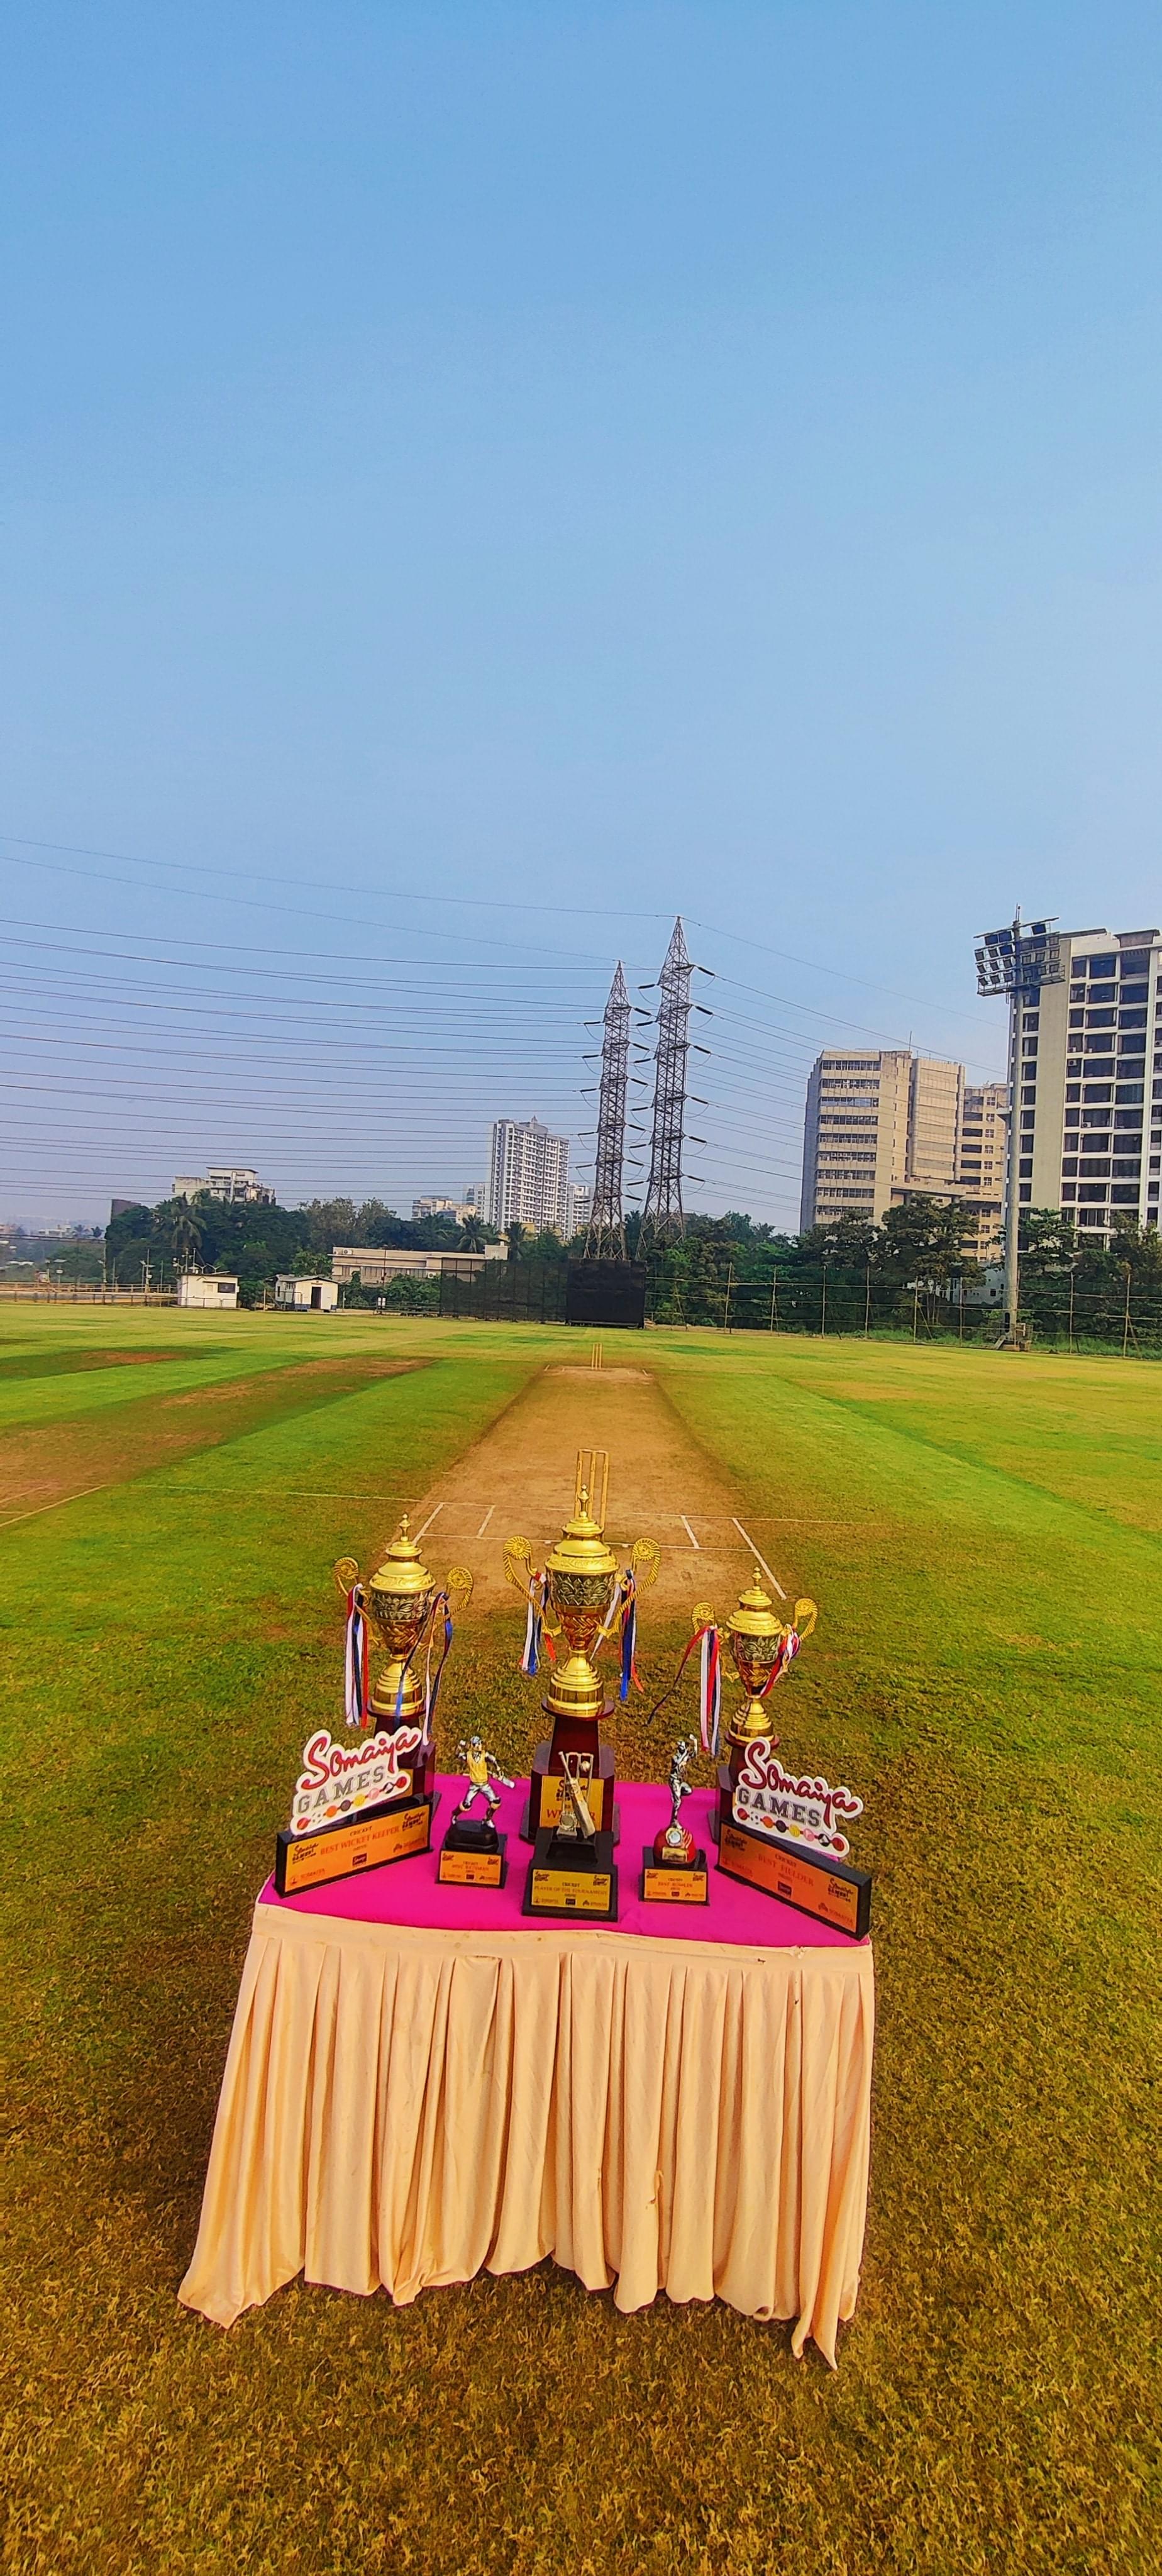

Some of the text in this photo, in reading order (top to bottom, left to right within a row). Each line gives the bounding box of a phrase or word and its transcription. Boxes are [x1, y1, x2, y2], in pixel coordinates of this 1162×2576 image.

[301, 1733, 419, 1789] Somaiya
[298, 1765, 384, 1813] GAMES
[741, 1741, 858, 1829] Somaiya
[738, 1788, 821, 1827] GAMES
[321, 1844, 338, 1855] BEST
[341, 1835, 369, 1848] WICKET
[372, 1826, 399, 1840] KEEPER
[758, 1853, 776, 1867] BEST
